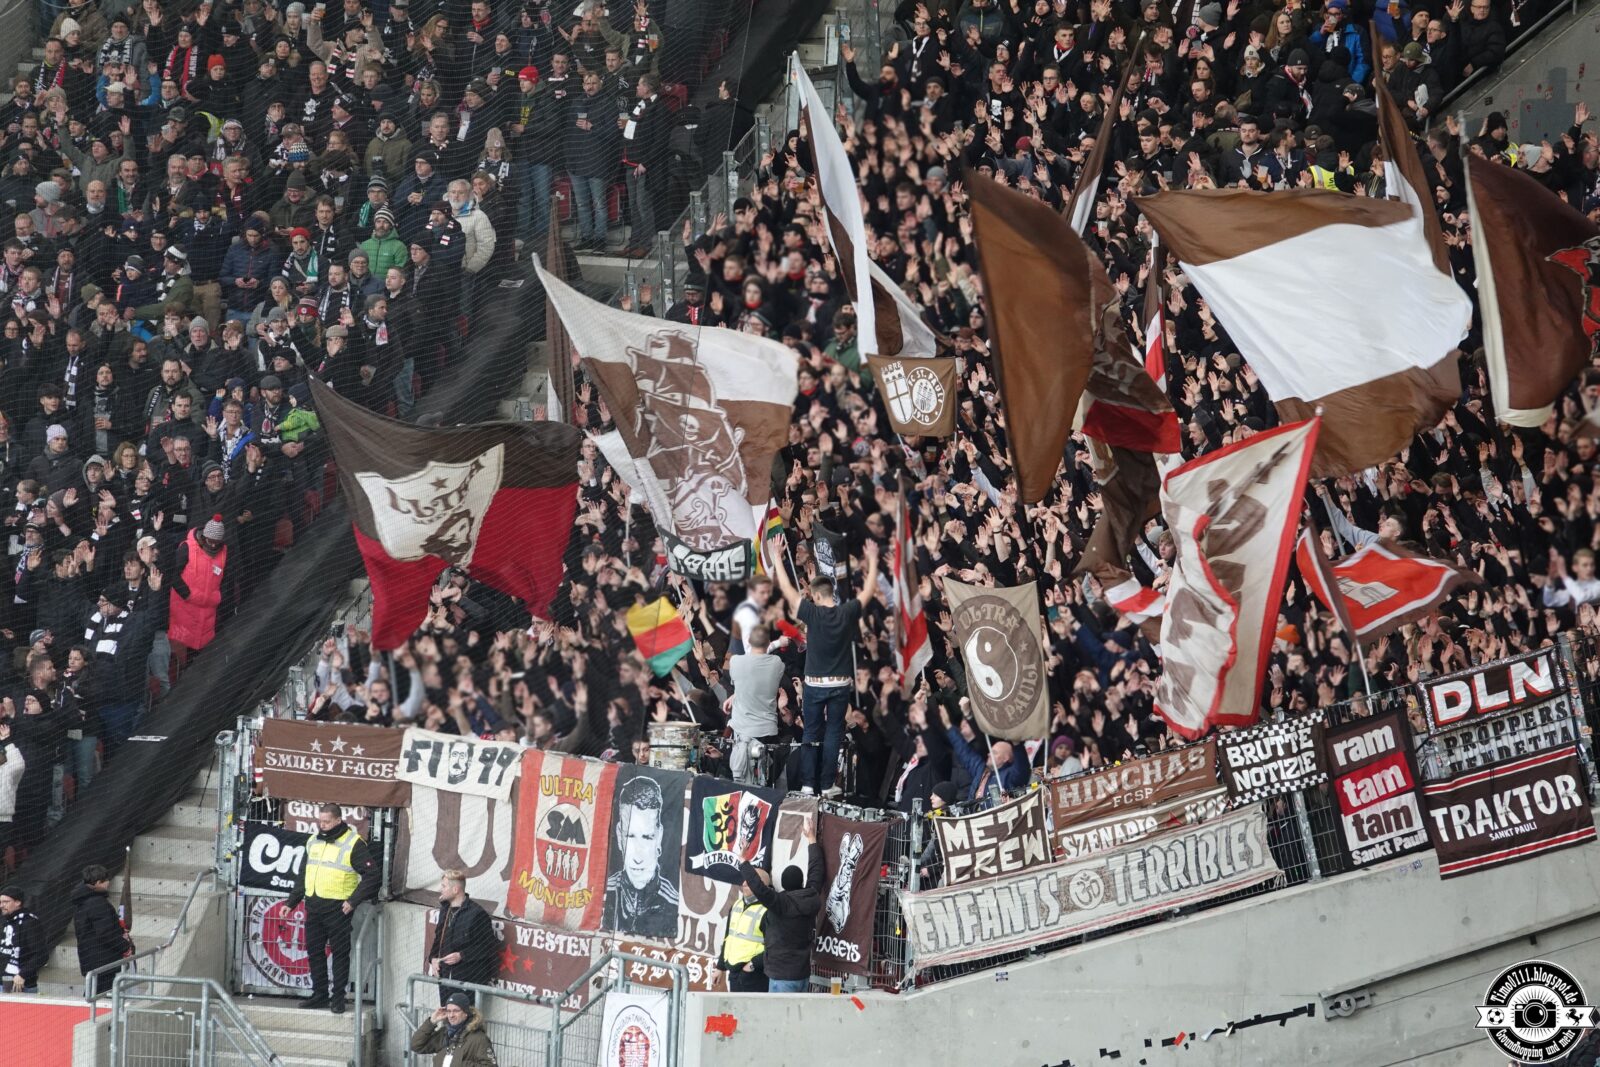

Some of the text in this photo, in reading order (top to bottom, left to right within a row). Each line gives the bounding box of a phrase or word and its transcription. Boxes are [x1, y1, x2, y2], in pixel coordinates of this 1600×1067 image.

[1432, 656, 1556, 726] DLN
[265, 751, 337, 773] SMILEY
[1226, 726, 1314, 768] BRUTTE
[1333, 723, 1396, 767] ram
[1056, 747, 1206, 809] HINCHAS
[1232, 750, 1317, 793] NOTIZIE
[1341, 761, 1408, 808] tam
[287, 800, 365, 821] GRPO
[1112, 787, 1154, 809] FCSP
[1429, 773, 1584, 843] TRAKTOR
[940, 799, 1039, 852] METT
[1352, 803, 1414, 844] tam
[1489, 821, 1538, 842] SANKT PAULI
[949, 828, 1049, 884] CREW
[1351, 828, 1429, 866] Sankt Pauli
[912, 816, 1267, 952] ENFANTS TERRIBLES
[515, 924, 591, 957] WESTEN
